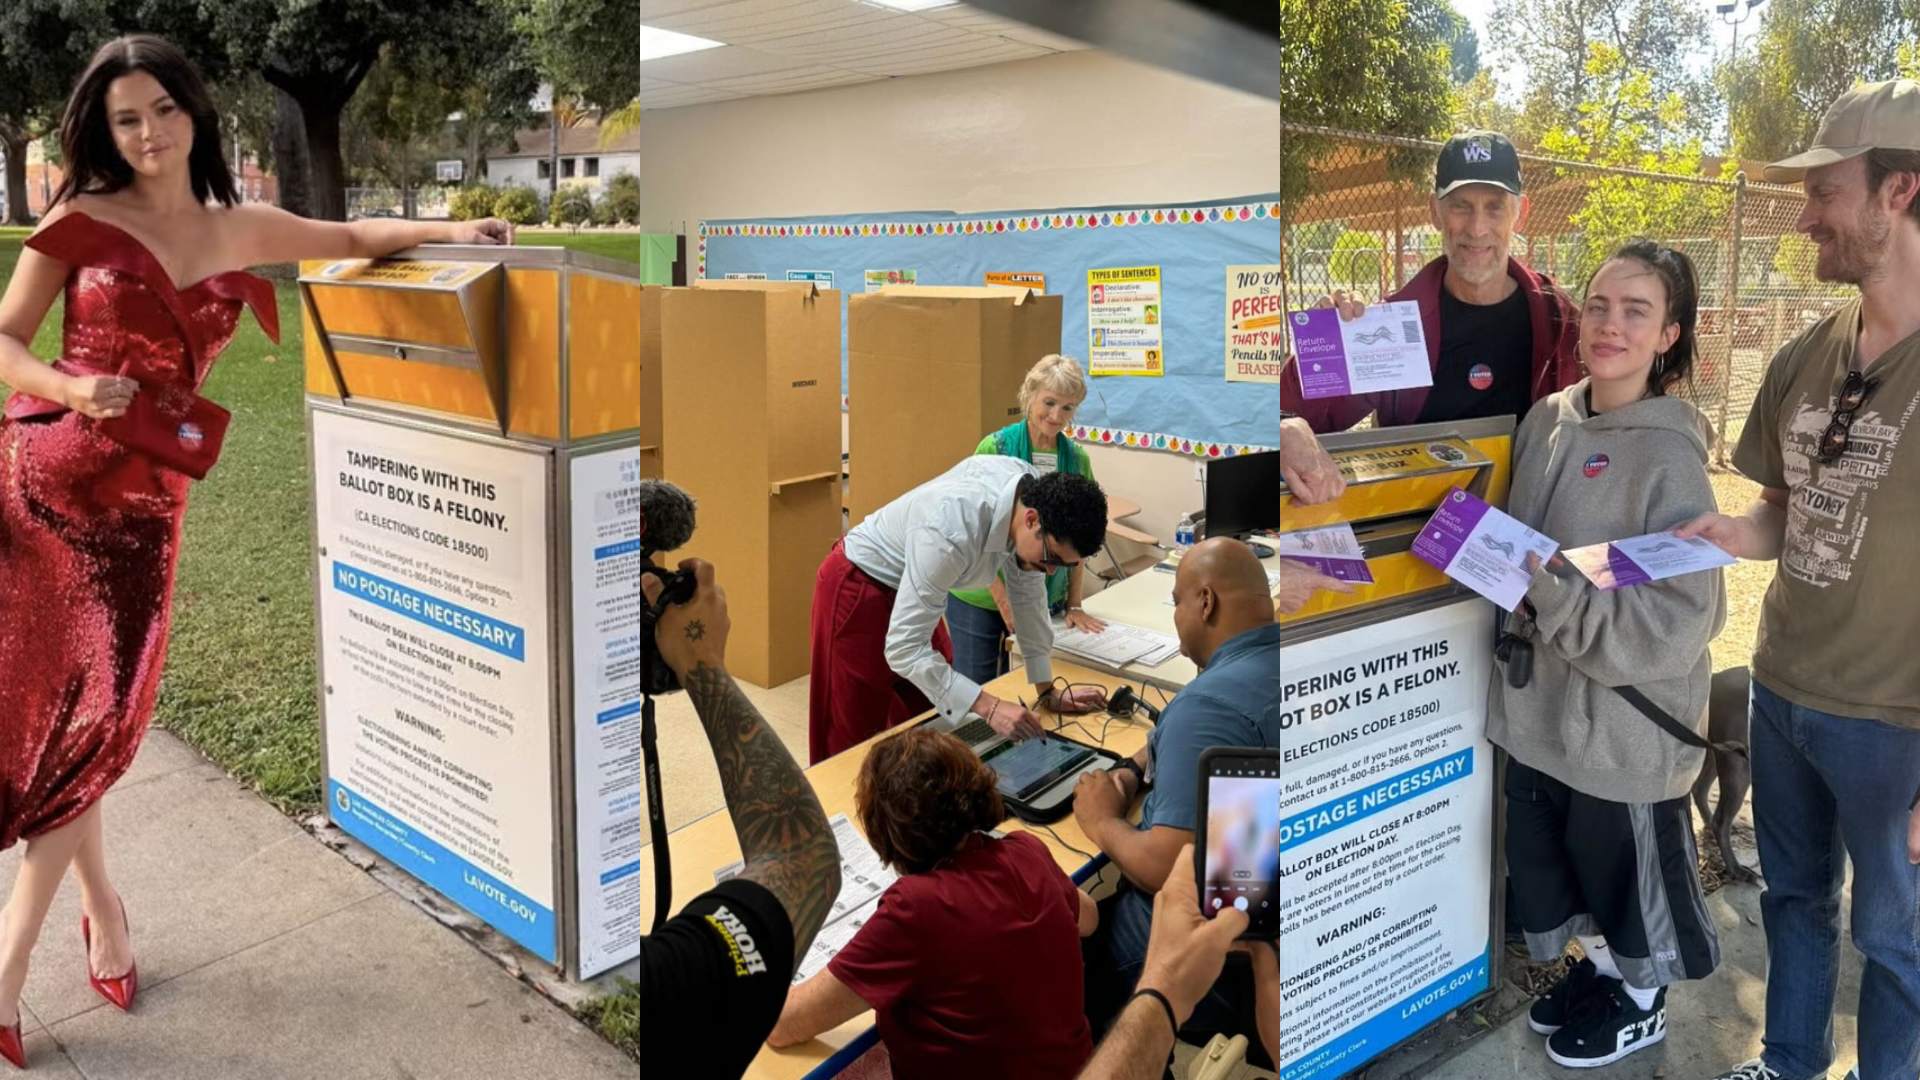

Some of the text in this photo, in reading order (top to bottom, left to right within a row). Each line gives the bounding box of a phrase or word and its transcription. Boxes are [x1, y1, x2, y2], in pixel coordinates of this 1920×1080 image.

[1464, 147, 1491, 162] WS
[1092, 268, 1156, 280] TYPES OF SENTENCES
[1237, 272, 1259, 288] NO
[1232, 332, 1268, 346] THAT'S
[1232, 348, 1267, 360] Pencils
[1298, 338, 1326, 346] Return
[1299, 344, 1336, 353] Envelope
[347, 450, 496, 501] TAMPERING WITH THIS
[1366, 448, 1420, 460] BALLOT
[1376, 460, 1410, 470] BOX
[339, 472, 509, 532] BALLOT BOX IS A FELONY.
[354, 508, 489, 562] (CA ELECTIONS CODE 18500)
[338, 568, 358, 588] NO
[360, 576, 421, 614] POSTAGE
[424, 601, 516, 650] NECESSARY
[348, 608, 364, 622] THIS
[365, 616, 392, 634] BALLOT
[392, 626, 408, 640] BOX
[410, 633, 428, 650] WILL
[430, 642, 454, 662] CLOSE
[456, 652, 468, 666] AT
[386, 638, 398, 650] ON
[399, 642, 435, 666] ELECTION
[1280, 640, 1449, 703] PERING WITH THIS
[1310, 694, 1352, 720] BOX
[1356, 688, 1372, 706] IS
[1377, 682, 1390, 700] A
[1394, 661, 1461, 694] FELONY.
[394, 708, 446, 742] WARNING:
[1284, 699, 1440, 763] ELECTIONS CODE 18500)
[1280, 789, 1314, 809] contact
[1317, 785, 1328, 794] us
[1330, 780, 1339, 790] at
[1414, 743, 1440, 758] Option
[1352, 760, 1362, 769] or
[1364, 755, 1370, 764] if
[1372, 751, 1387, 764] you
[1389, 743, 1408, 755] have
[1410, 737, 1424, 748] any
[1280, 756, 1466, 844] OSTAGE NECESSARY
[1305, 834, 1398, 882] ON ELECTION DAY.
[1316, 846, 1338, 863] BOX
[1341, 834, 1367, 852] WILL
[1369, 819, 1400, 840] CLOSE
[1402, 813, 1415, 826] AT
[1416, 798, 1450, 820] 8:00PM
[1287, 908, 1302, 920] are
[1304, 894, 1332, 912] voters
[1334, 890, 1342, 898] in
[1344, 881, 1360, 894] line
[1362, 876, 1372, 886] or
[1374, 869, 1387, 880] the
[1389, 860, 1407, 872] time
[1408, 854, 1420, 864] for
[1421, 848, 1434, 858] the
[1294, 894, 1306, 904] be
[1308, 874, 1348, 898] accepted
[1350, 864, 1370, 879] after
[1404, 845, 1414, 855] on
[1416, 830, 1446, 849] Election
[1302, 914, 1318, 926] has
[1321, 902, 1343, 917] been
[1344, 882, 1383, 906] extended
[1384, 877, 1394, 887] by
[1402, 862, 1423, 878] court
[464, 869, 537, 924] LAVOTE.GOV
[713, 905, 767, 976] HORA
[1316, 906, 1386, 948] WARNING:
[1342, 933, 1380, 958] AND/OR
[1382, 904, 1438, 938] CORRUPTING
[1282, 918, 1432, 1002] VOTING PROCESS IS PROHIBITED!
[1295, 958, 1389, 1012] subject to fines and/or
[1313, 990, 1361, 1020] information
[1362, 984, 1374, 994] on
[1375, 975, 1388, 986] the
[1390, 951, 1433, 980] prohibitions
[1298, 968, 1474, 1072] COUNTY LAVOTE.GOV
[1302, 1028, 1330, 1050] please
[1333, 1018, 1350, 1032] visit
[1352, 1010, 1365, 1021] our
[1368, 992, 1397, 1012] website
[1304, 1022, 1320, 1036] and
[1323, 1010, 1343, 1026] what
[1346, 986, 1388, 1014] constitutes
[1390, 963, 1429, 990] corruption
